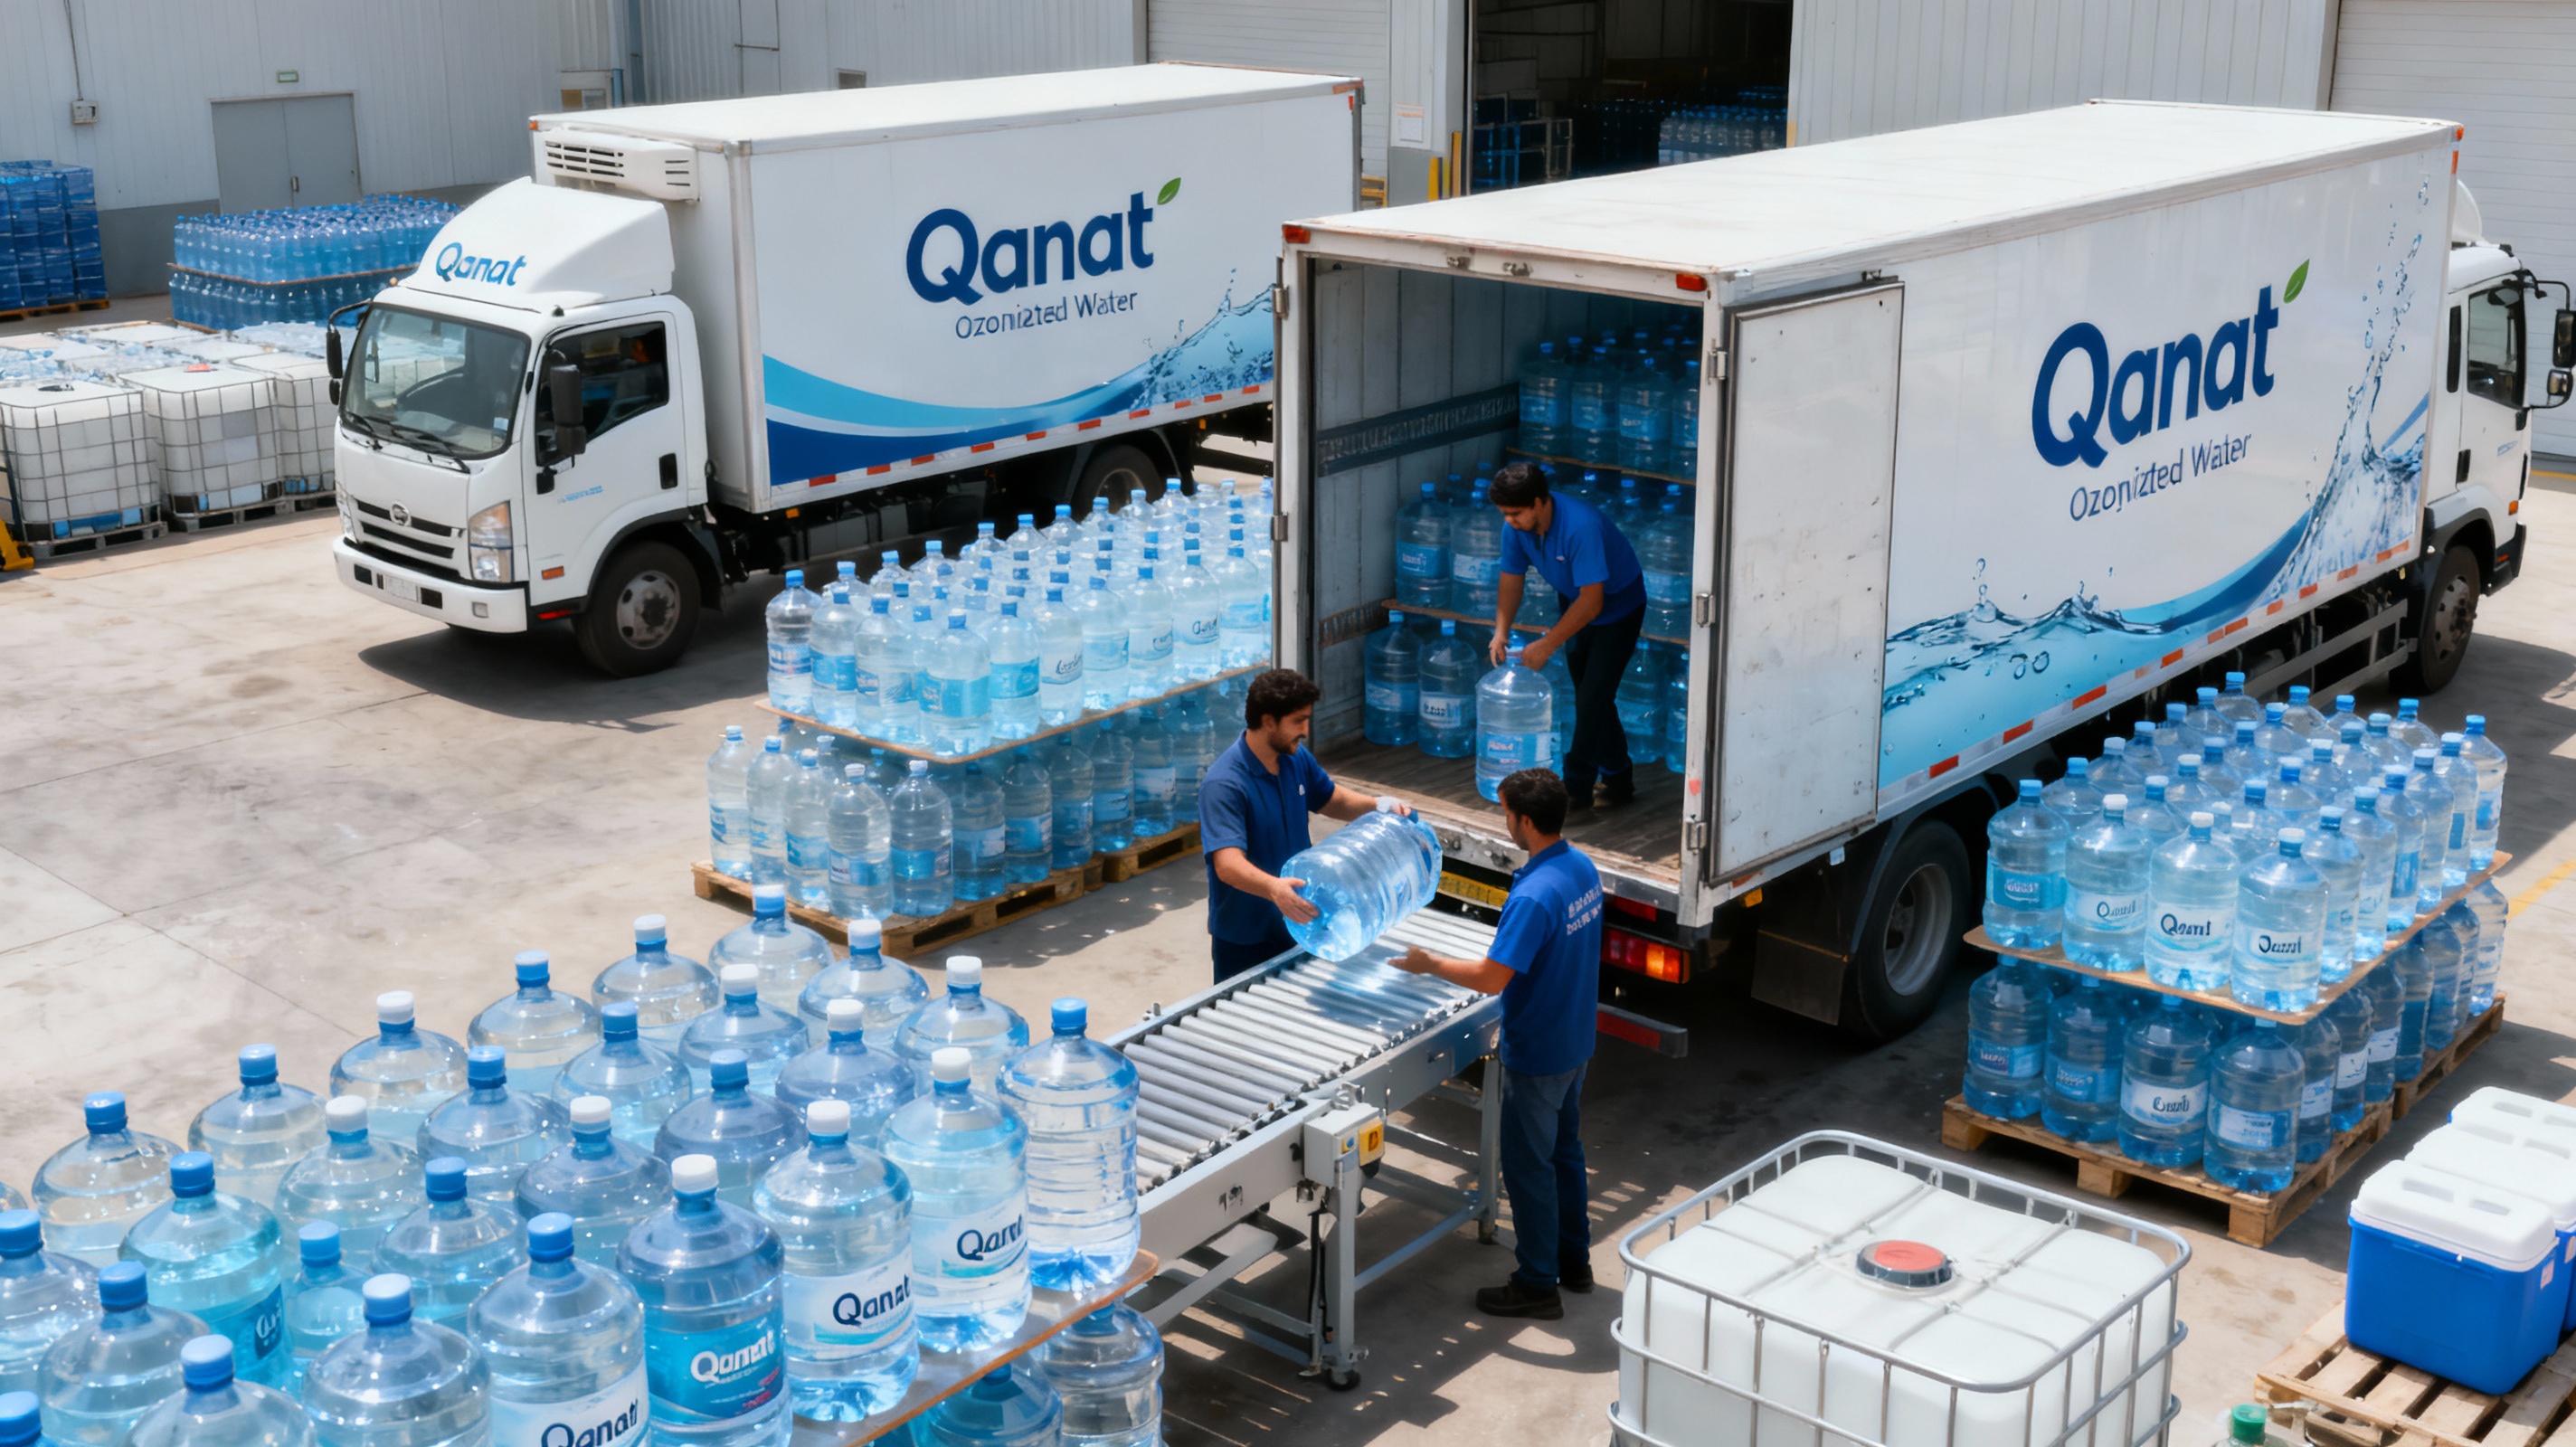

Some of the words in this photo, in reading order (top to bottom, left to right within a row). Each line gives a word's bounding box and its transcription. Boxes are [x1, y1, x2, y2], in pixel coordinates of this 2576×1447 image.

[436, 241, 527, 287] Qanat
[906, 191, 1154, 306] Qanat
[1074, 289, 1138, 318] Water
[2031, 283, 2279, 469] Qanat
[2192, 433, 2252, 478] Water
